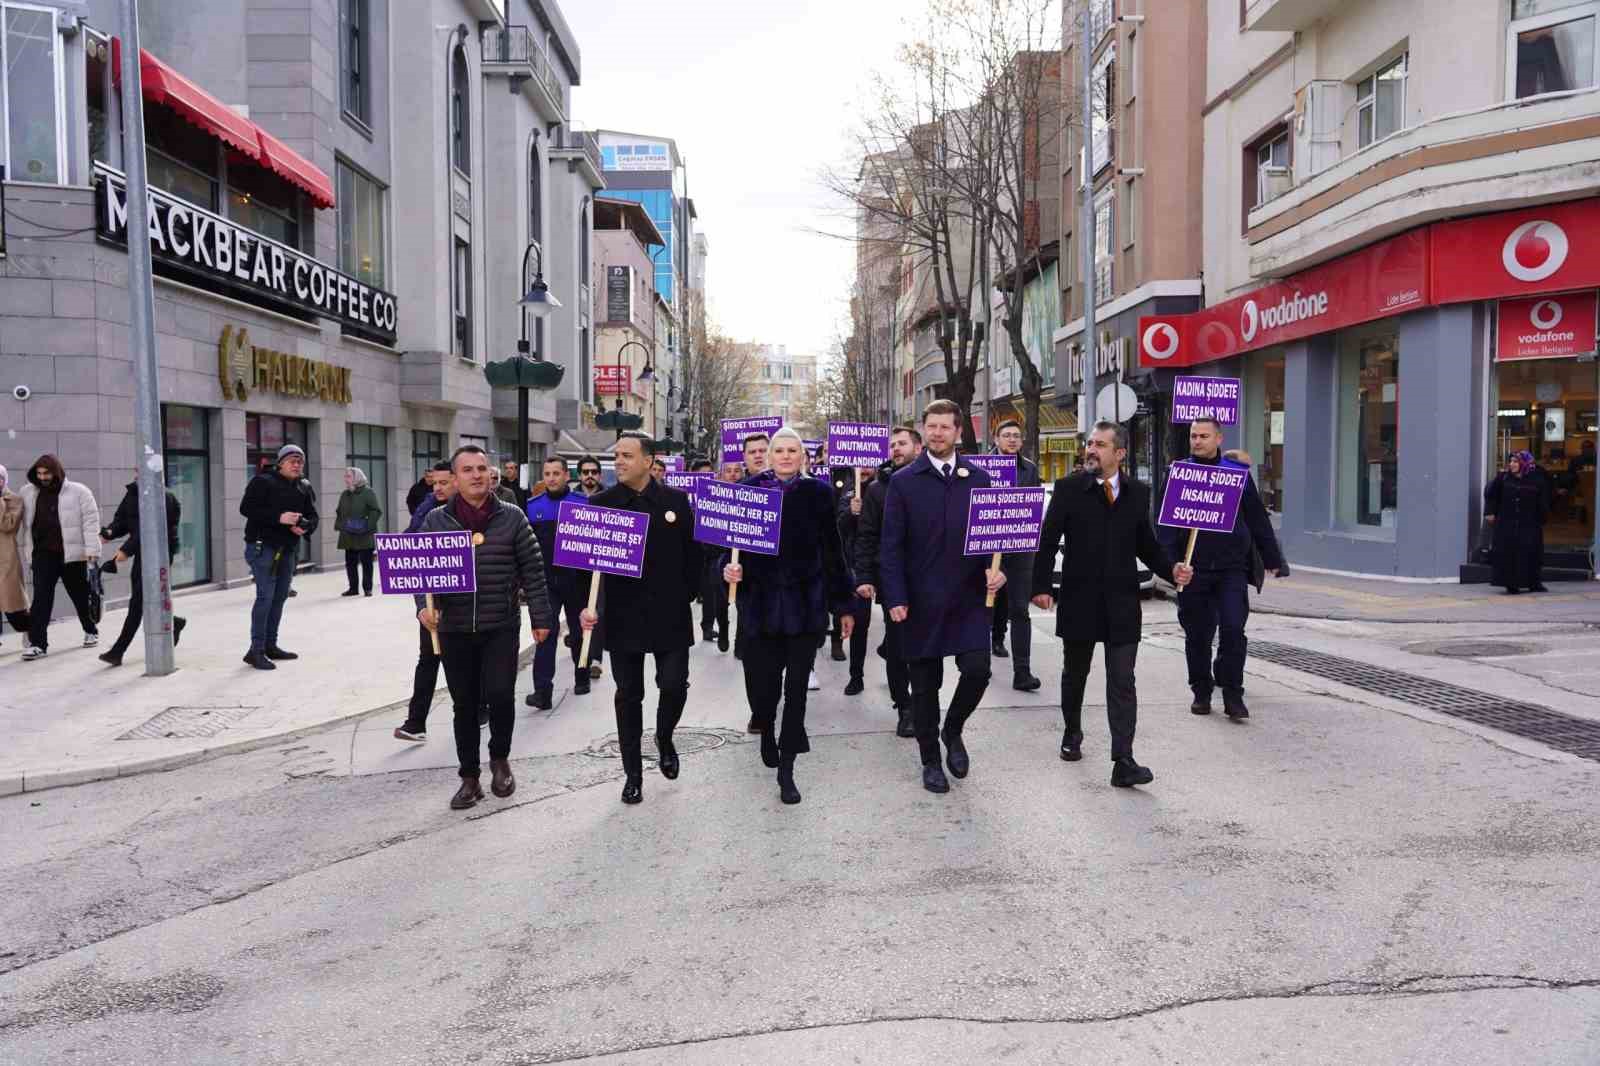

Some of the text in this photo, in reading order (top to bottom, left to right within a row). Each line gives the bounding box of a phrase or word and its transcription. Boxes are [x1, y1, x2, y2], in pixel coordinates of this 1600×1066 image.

[105, 174, 288, 293] MACKBEAR
[294, 258, 369, 324] COFFEE
[1260, 291, 1329, 331] vodafone
[1518, 330, 1574, 344] vodafone
[252, 346, 353, 404] HALKBANK
[1176, 380, 1238, 402] KADINA ŞİDDETE
[1176, 404, 1235, 422] TOLERANS YOK !
[723, 420, 746, 432] ŞİDDET
[830, 425, 859, 436] KADINA
[724, 443, 737, 453] SON
[1171, 466, 1243, 489] KADINA ŞİDDET,
[735, 488, 769, 505] YÜZÜNDE
[972, 491, 1044, 507] KADINA ŞİDDETE HAYIR
[1180, 485, 1225, 505] İNSANLIK
[601, 511, 636, 528] YÜZÜNDE
[697, 499, 778, 523] GÖRDÜĞÜMÜZ HER ŞEY
[978, 508, 1033, 520] DEMEK ZORUNDA
[1172, 507, 1225, 525] SUÇUDUR !
[701, 516, 729, 530] KADININ
[970, 521, 1040, 536] BIRAKILMAYACAĞIMIZ
[376, 532, 471, 551] KADINLAR KENDİ
[559, 520, 643, 546] GÖRDÜĞÜMÜZ HER ŞEY
[561, 540, 592, 554] KADININ
[968, 540, 980, 552] BİR
[981, 539, 1001, 551] HAYAT
[387, 555, 464, 570] KARARLARINI
[389, 572, 423, 589] KENDİ
[425, 571, 459, 588] VERİR
